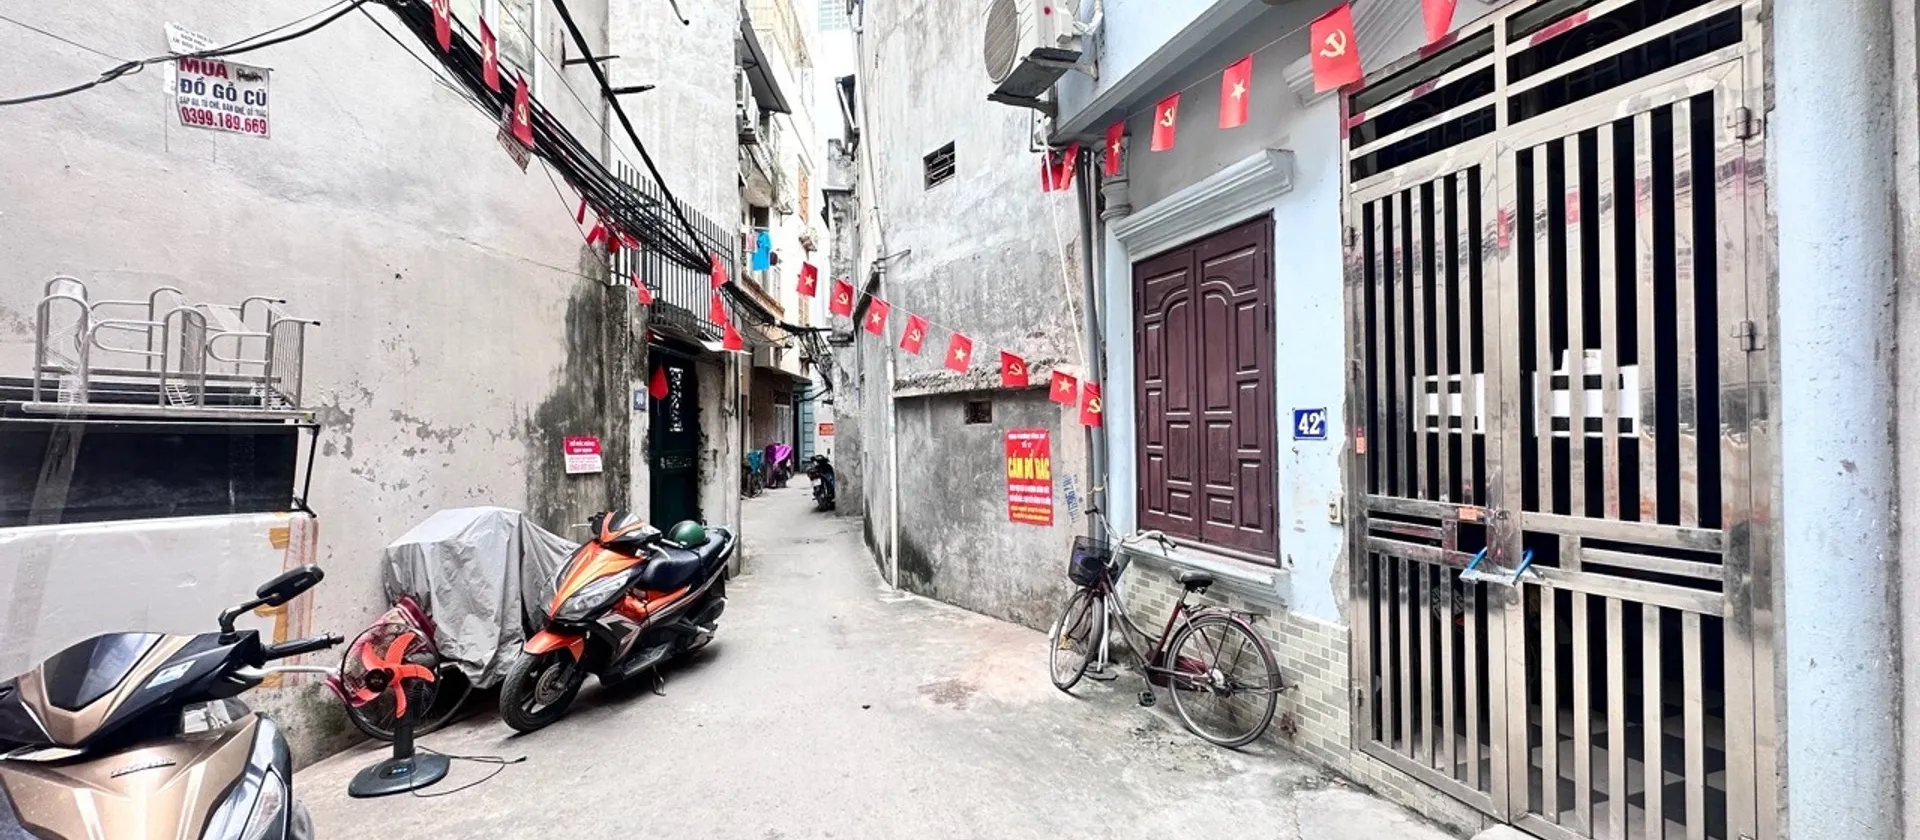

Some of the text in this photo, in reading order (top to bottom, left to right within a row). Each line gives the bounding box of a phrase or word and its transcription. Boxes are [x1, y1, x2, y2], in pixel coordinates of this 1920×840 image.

[179, 57, 228, 80] MUA
[244, 88, 267, 107] CŨ
[181, 106, 267, 135] 0399.189.669
